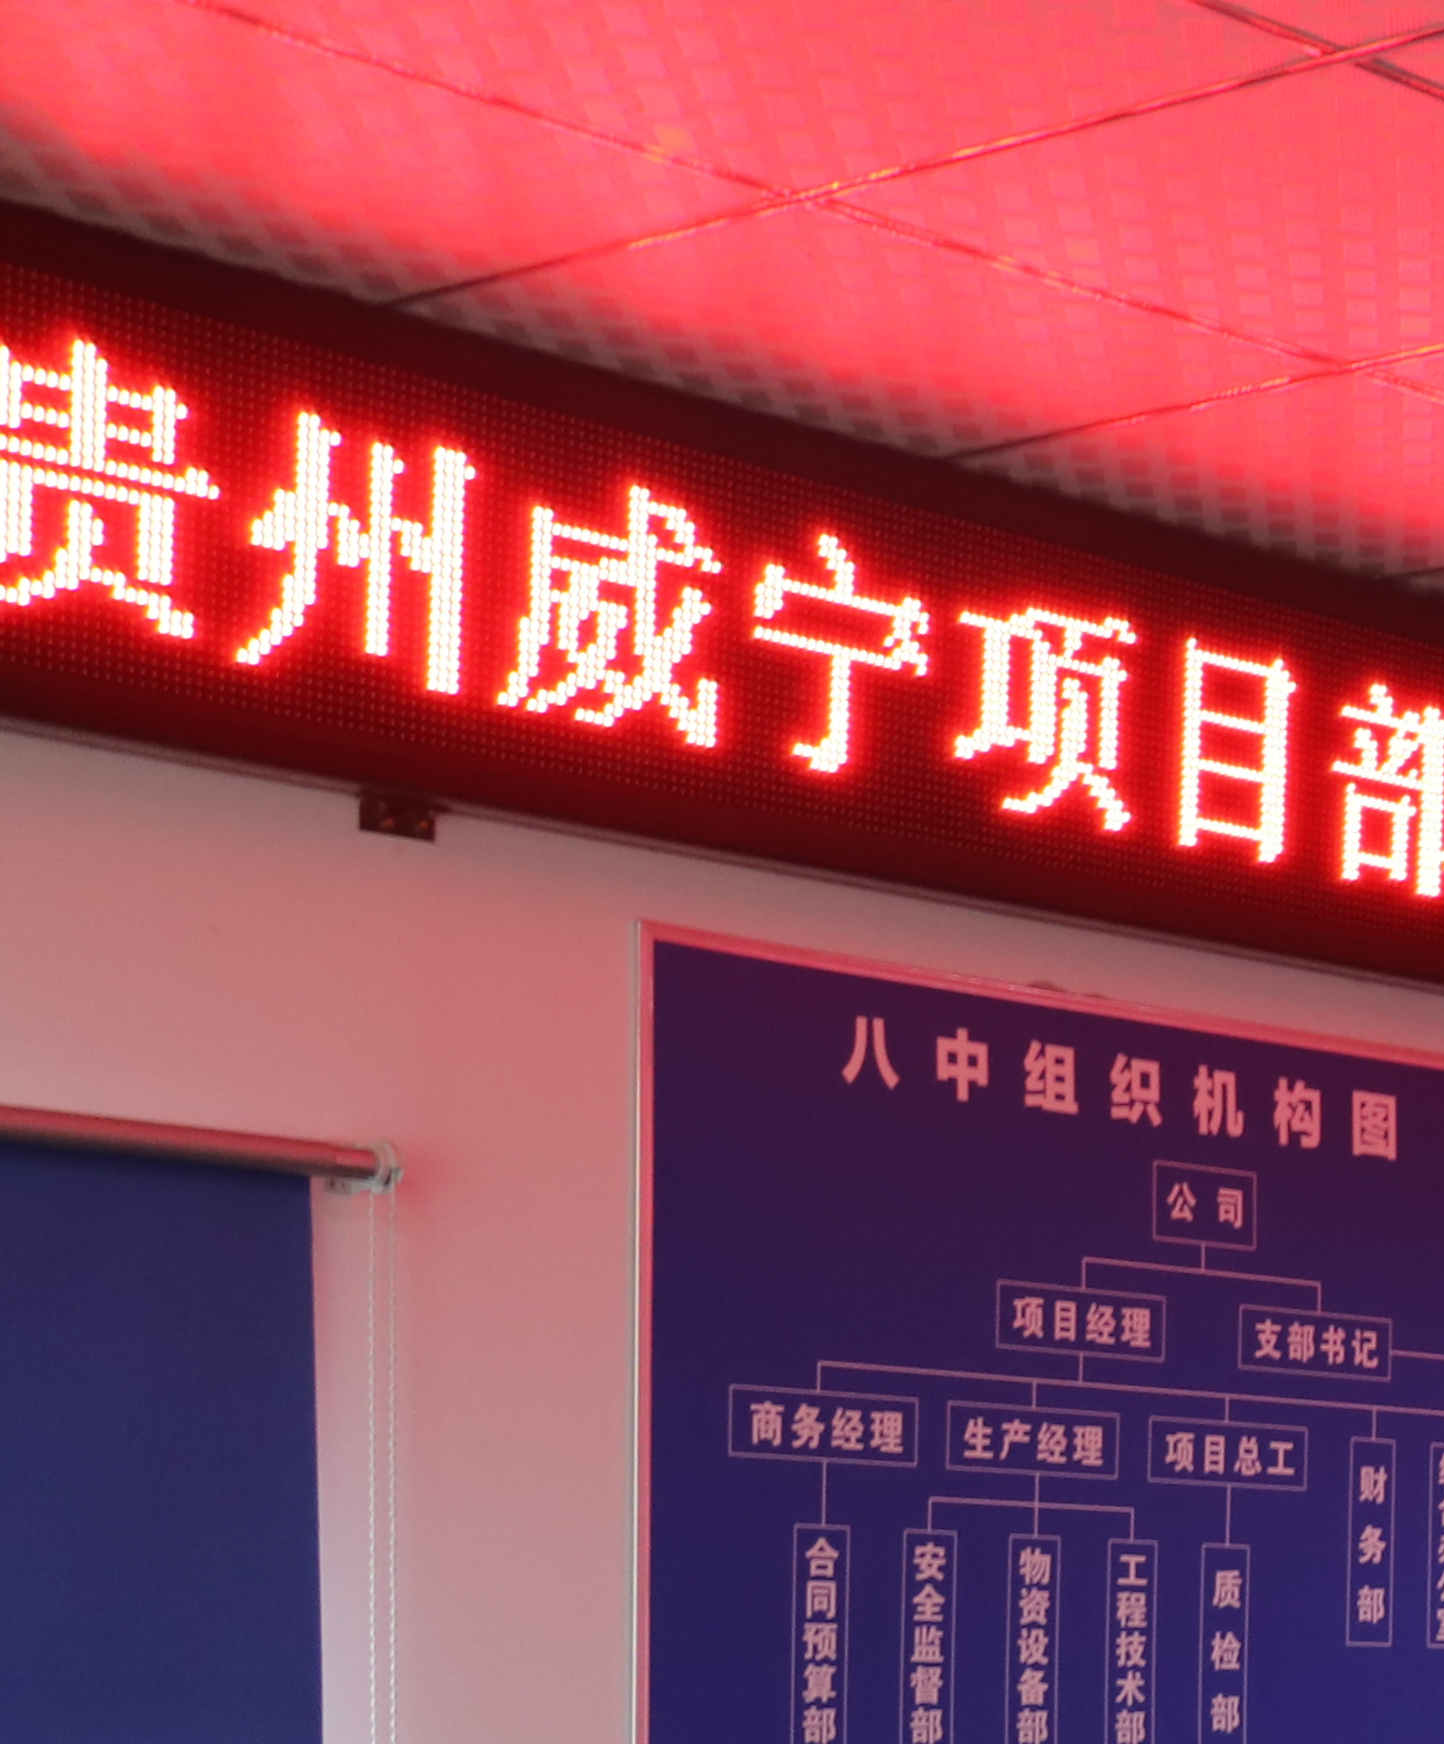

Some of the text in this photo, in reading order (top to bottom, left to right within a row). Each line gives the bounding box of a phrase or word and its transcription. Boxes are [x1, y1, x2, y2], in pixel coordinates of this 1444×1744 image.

[841, 1014, 1400, 1162] 八中组织机构图
[1166, 1180, 1245, 1230] 公司
[1011, 1296, 1153, 1349] 项目经理
[1253, 1319, 1380, 1369] 支部书记
[749, 1400, 906, 1455] 商务经理
[962, 1415, 1105, 1468] 生产经理
[1164, 1431, 1297, 1478] 项目总工
[1356, 1465, 1387, 1625] 财务部
[1211, 1569, 1242, 1735] 质检部
